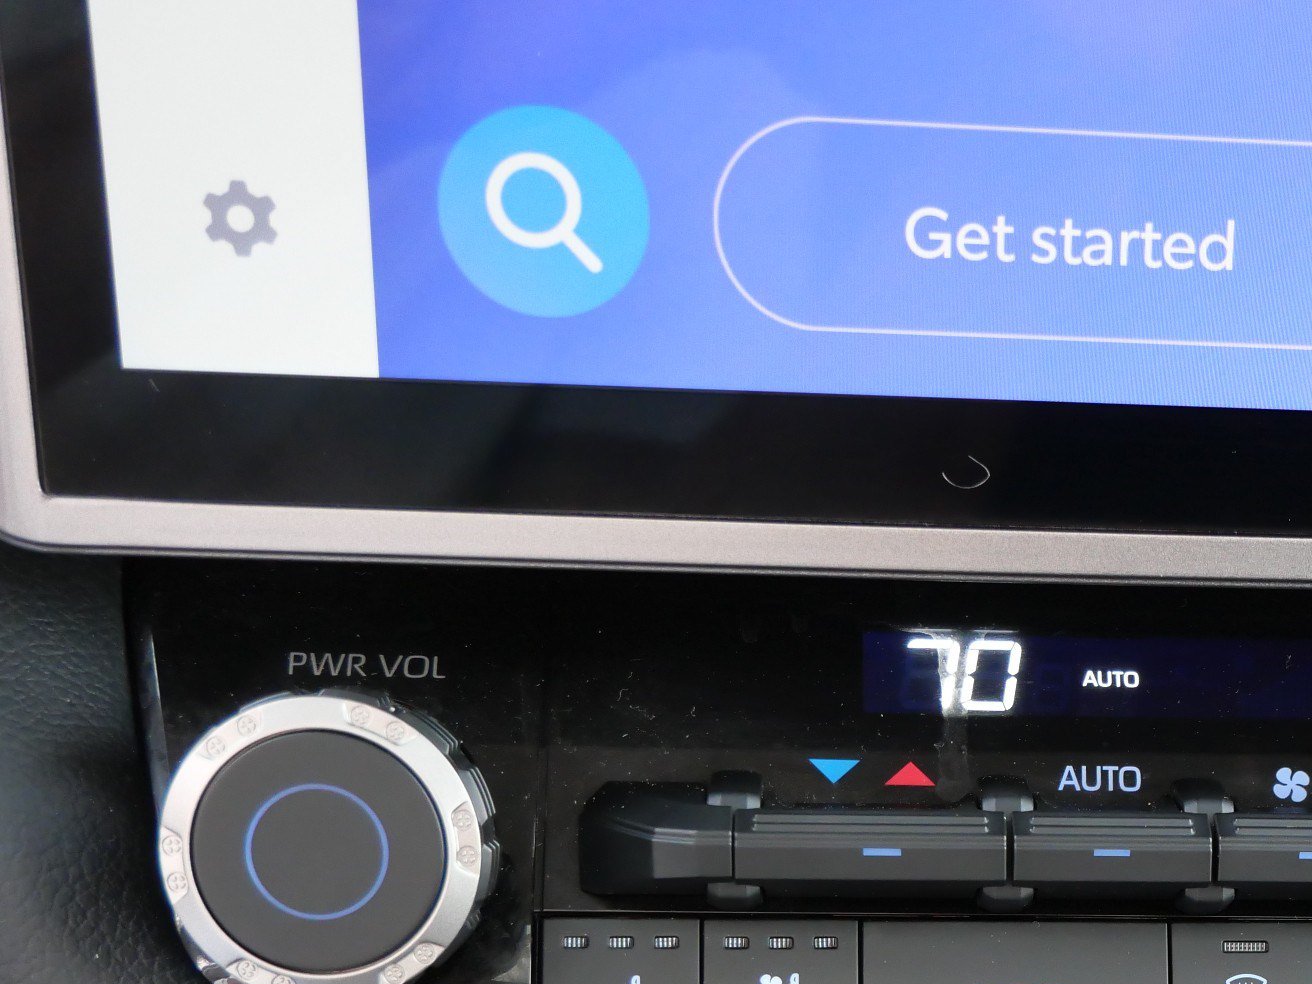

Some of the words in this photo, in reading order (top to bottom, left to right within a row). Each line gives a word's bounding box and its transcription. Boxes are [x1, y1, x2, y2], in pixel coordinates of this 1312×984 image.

[904, 206, 1016, 263] Get
[1030, 217, 1236, 272] started
[287, 651, 368, 677] PWR
[379, 653, 446, 679] VOL
[906, 638, 1022, 712] 70
[1082, 669, 1140, 689] AUTO
[1057, 765, 1142, 793] AUTO
